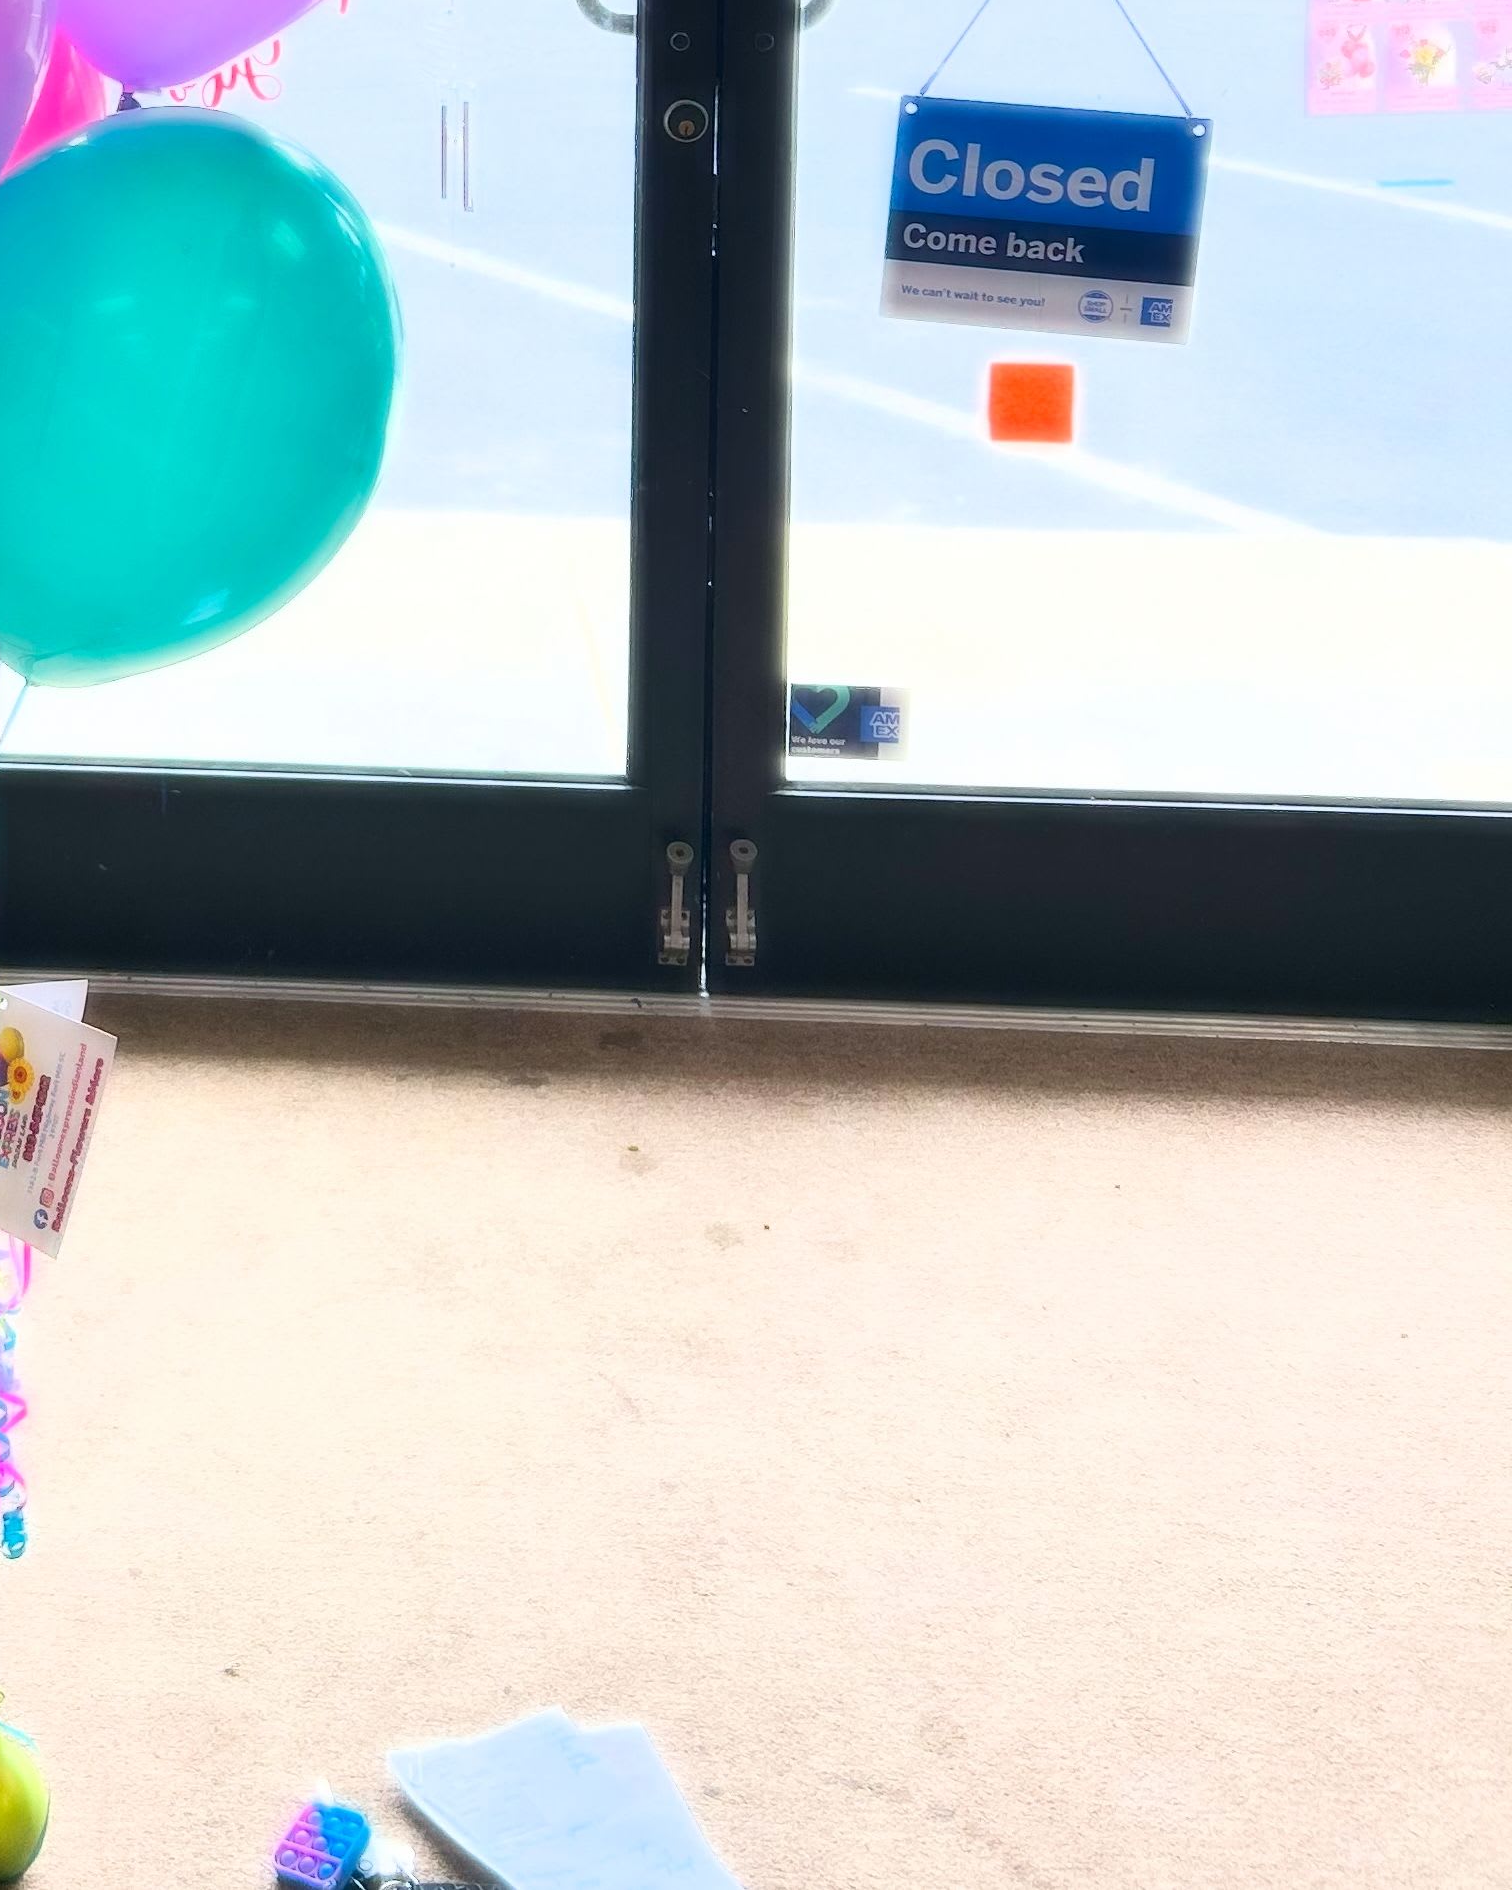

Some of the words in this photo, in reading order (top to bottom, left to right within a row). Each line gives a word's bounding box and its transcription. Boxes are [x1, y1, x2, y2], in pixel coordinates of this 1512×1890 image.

[908, 139, 1155, 212] Closed
[903, 222, 997, 255] Come
[1006, 232, 1085, 263] back
[901, 284, 920, 296] We
[922, 287, 952, 299] can't
[954, 289, 978, 301] wait
[981, 291, 993, 302] to
[997, 295, 1017, 305] see
[1019, 296, 1045, 308] you!
